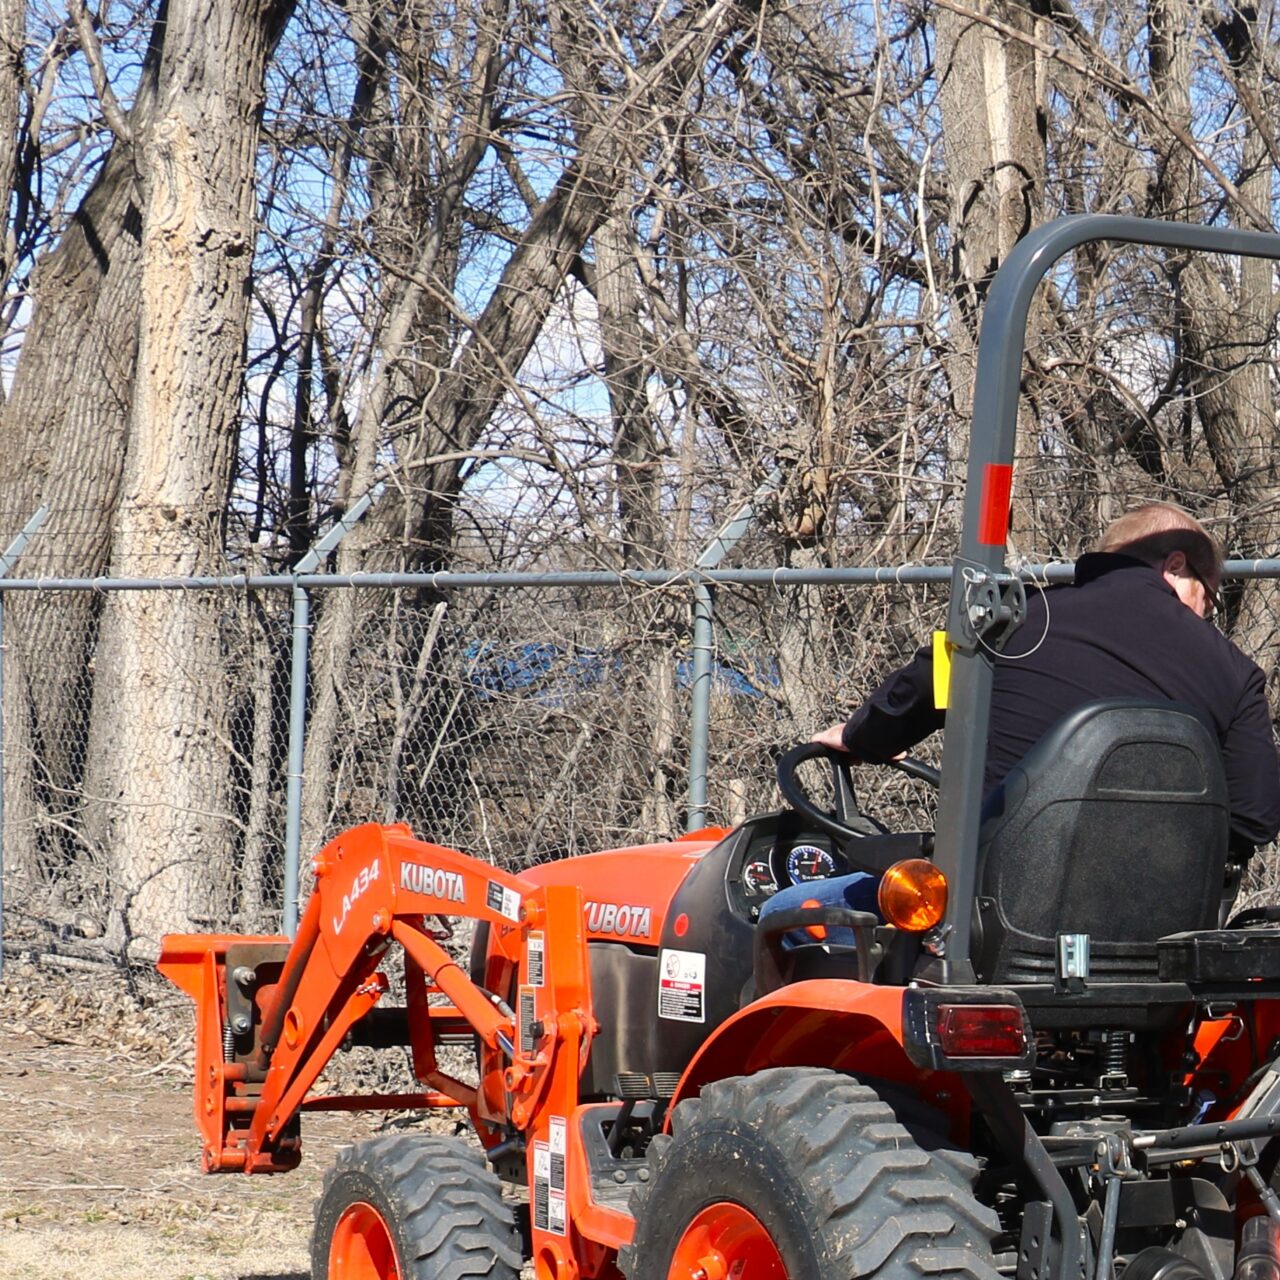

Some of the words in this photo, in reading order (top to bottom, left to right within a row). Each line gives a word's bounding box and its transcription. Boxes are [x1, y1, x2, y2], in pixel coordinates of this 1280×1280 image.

[333, 858, 379, 936] LA434
[400, 861, 464, 903] KUBOTA
[584, 901, 652, 938] UBOTA
